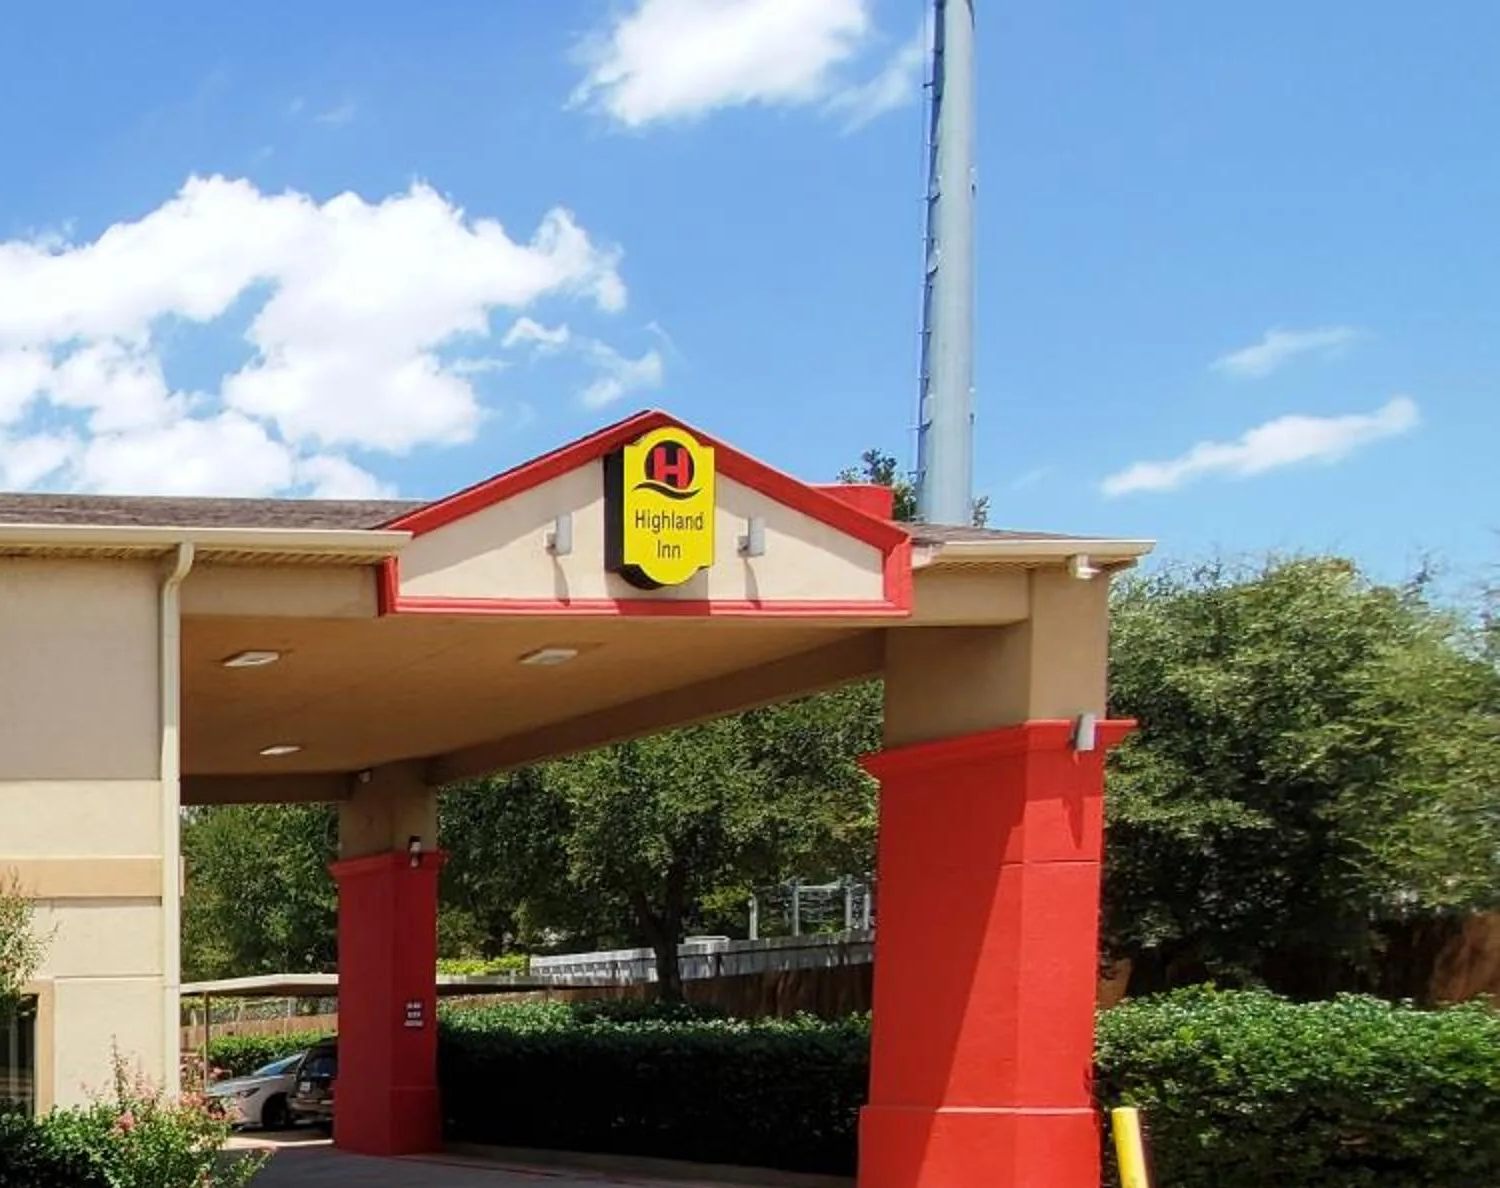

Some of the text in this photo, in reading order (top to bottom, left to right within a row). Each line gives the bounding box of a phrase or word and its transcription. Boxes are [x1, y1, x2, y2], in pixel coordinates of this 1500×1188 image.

[653, 447, 690, 489] H
[635, 510, 705, 533] Highland
[656, 540, 681, 558] Inn
